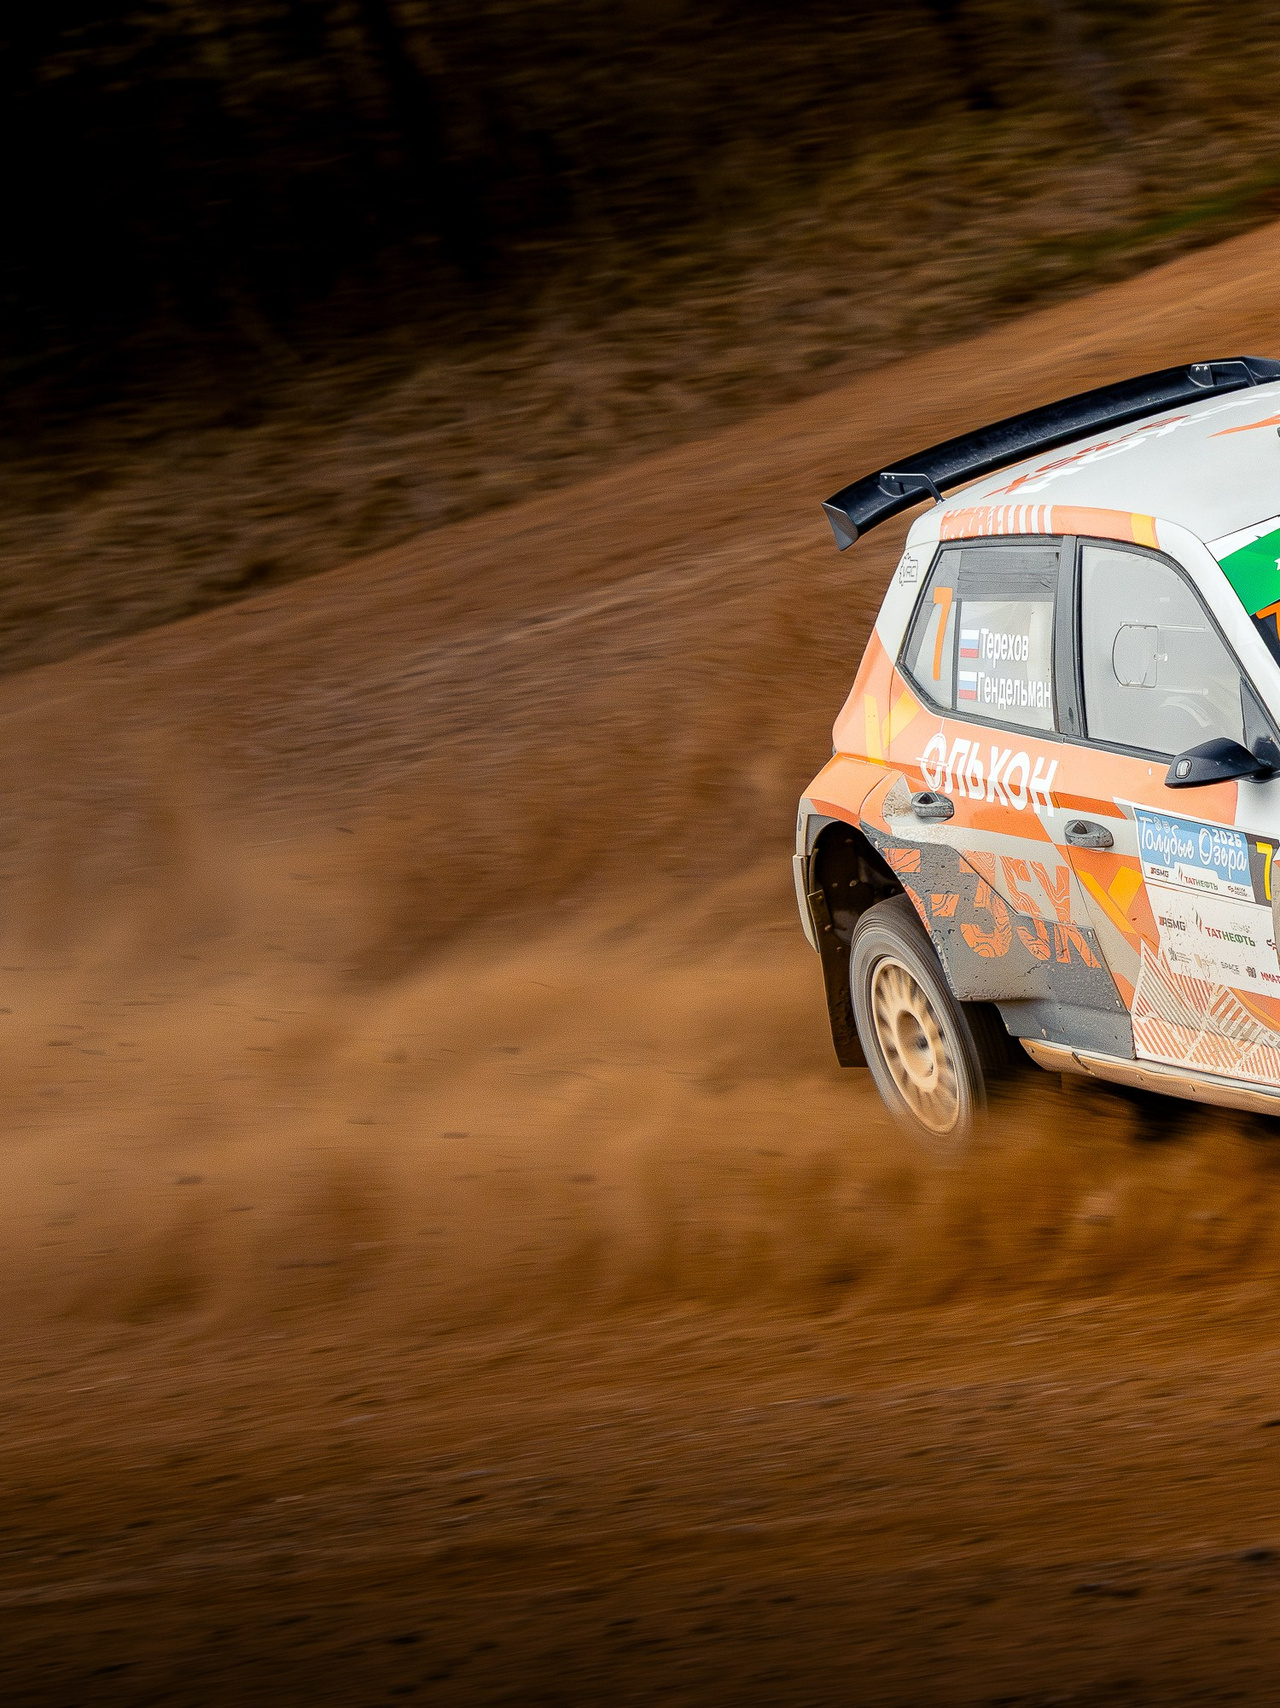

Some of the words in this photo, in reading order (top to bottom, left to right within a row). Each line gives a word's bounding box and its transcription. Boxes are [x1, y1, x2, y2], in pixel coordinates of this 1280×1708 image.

[933, 587, 953, 681] 7
[980, 628, 1029, 668] Терехов
[977, 671, 1051, 710] Гендельман
[919, 732, 1059, 817] ОЛЬХОН
[1139, 816, 1194, 865] Голубые
[1199, 827, 1247, 880] Озера
[1256, 841, 1273, 901] 7
[1184, 876, 1218, 891] ТАТНЕФТЬ
[1205, 926, 1256, 947] ТАТНЕФТЬ
